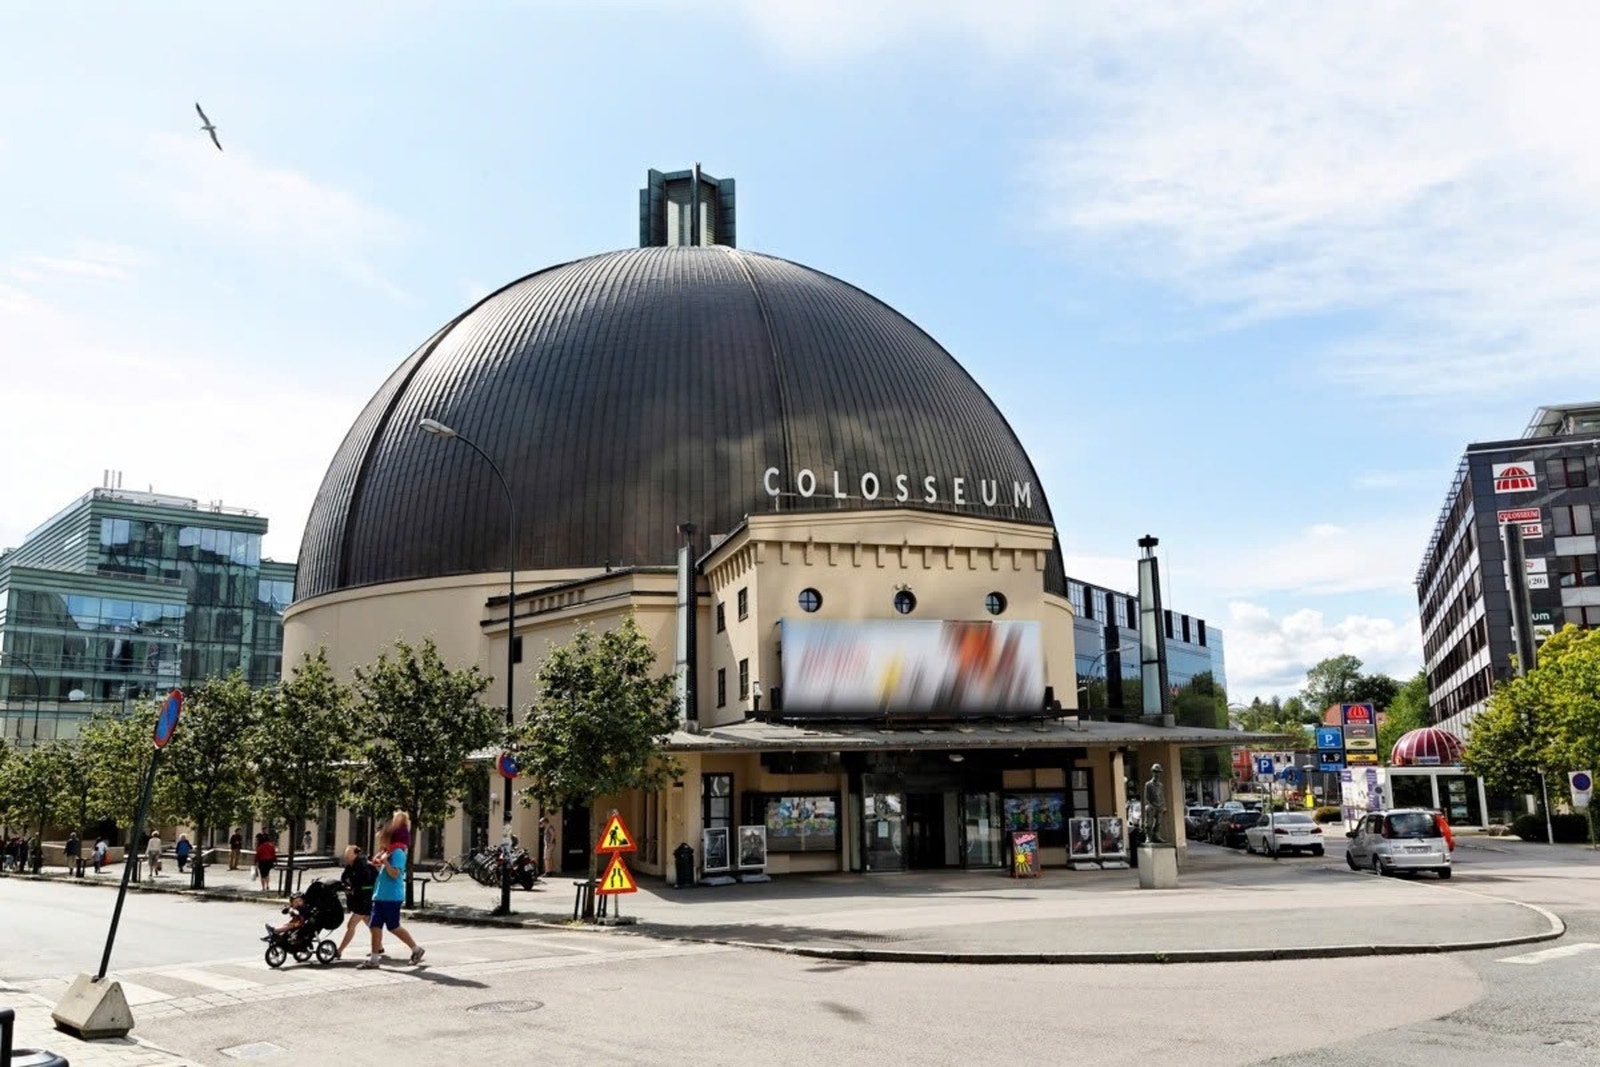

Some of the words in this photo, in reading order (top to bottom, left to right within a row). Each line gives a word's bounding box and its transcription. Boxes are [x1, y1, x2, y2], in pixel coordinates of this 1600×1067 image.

[763, 467, 1032, 509] COLOSSEUM
[1500, 510, 1537, 519] COLOSSEUM
[1325, 734, 1334, 744] P
[1260, 759, 1270, 773] P
